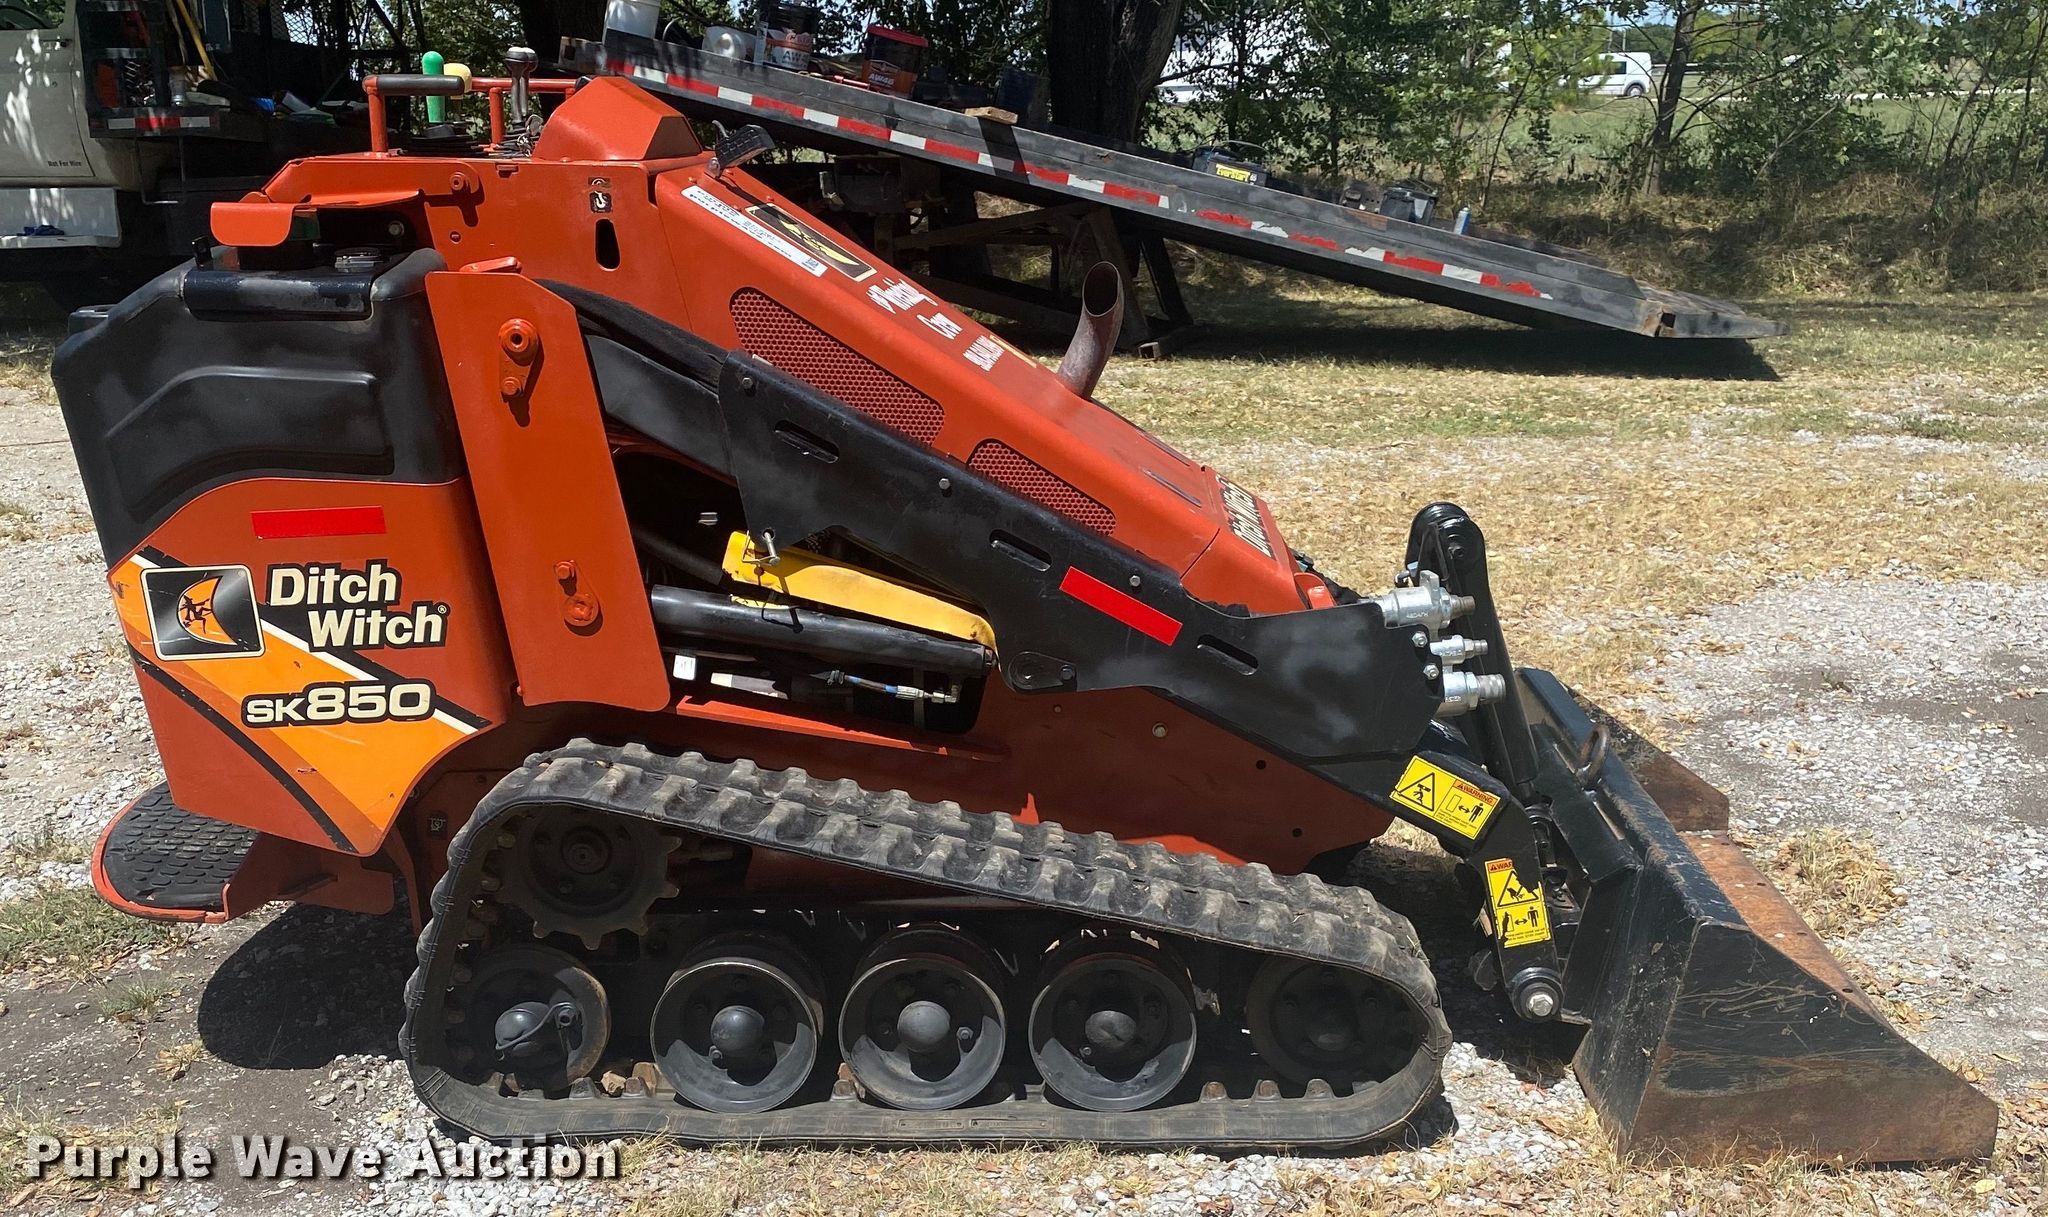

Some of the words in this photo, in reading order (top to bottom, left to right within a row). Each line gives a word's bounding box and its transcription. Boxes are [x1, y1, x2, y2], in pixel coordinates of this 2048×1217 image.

[270, 563, 397, 606] Ditch
[308, 605, 443, 648] Witch
[246, 683, 431, 724] SK850
[1463, 785, 1494, 804] WARNING
